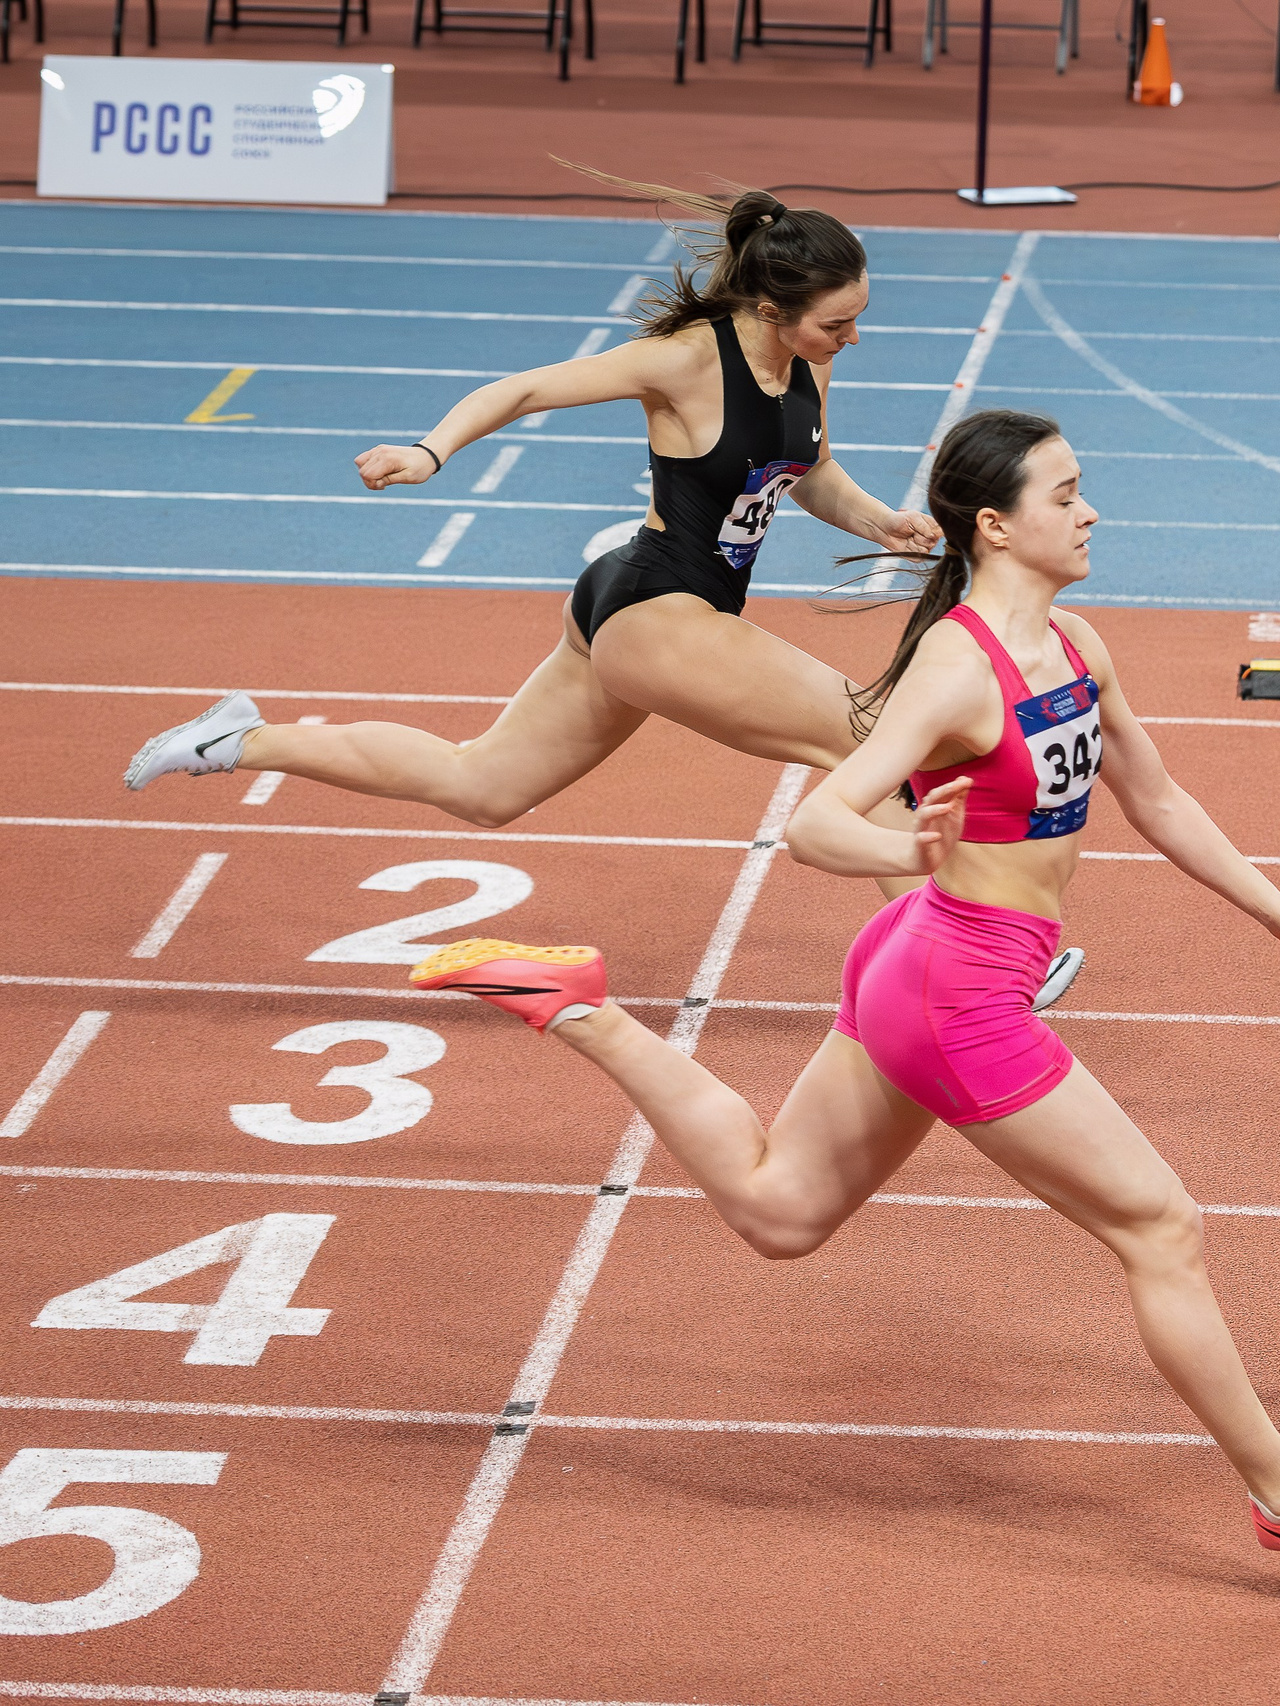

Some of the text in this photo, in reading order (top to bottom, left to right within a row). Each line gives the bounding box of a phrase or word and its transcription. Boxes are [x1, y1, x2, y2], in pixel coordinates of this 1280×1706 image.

[91, 101, 212, 156] РССС
[305, 859, 535, 965] 2
[228, 1019, 448, 1145] 3
[30, 1212, 337, 1367] 4
[0, 1447, 229, 1637] 5
